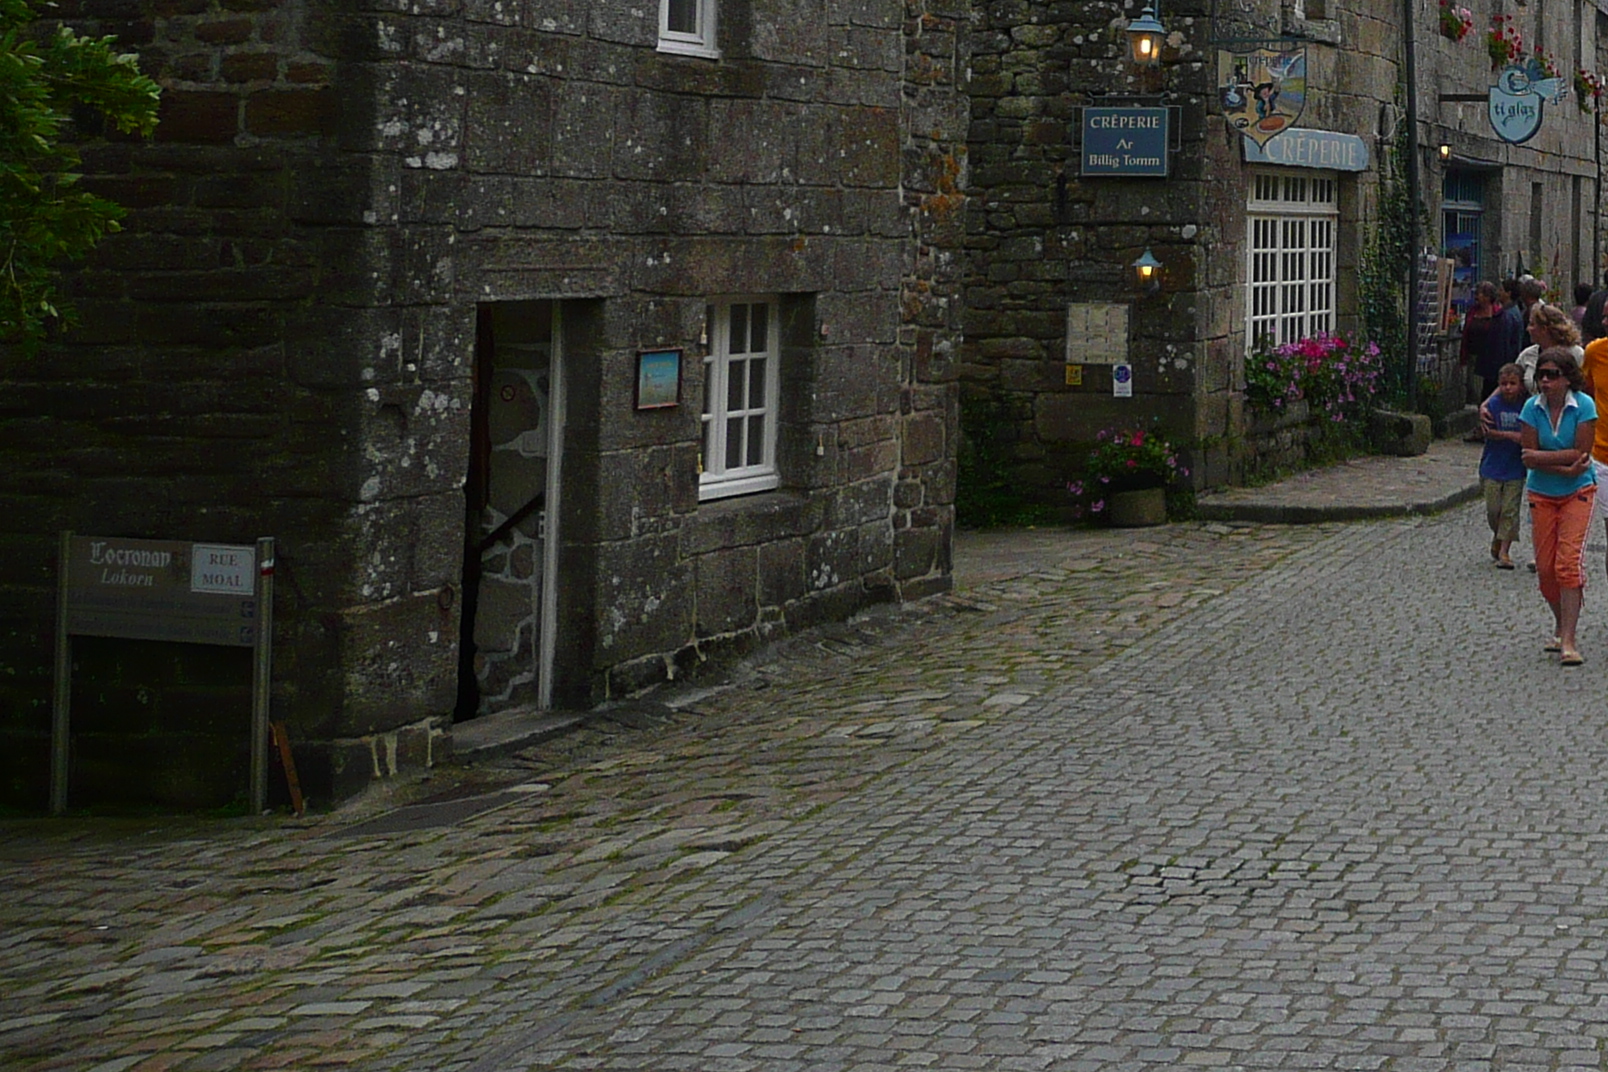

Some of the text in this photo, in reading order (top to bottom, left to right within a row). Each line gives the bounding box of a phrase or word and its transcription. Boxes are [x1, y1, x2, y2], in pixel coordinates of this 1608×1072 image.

[1090, 114, 1160, 129] CRÊPERIE
[1494, 100, 1535, 127] ti glaz
[1116, 138, 1134, 150] Ar
[1266, 131, 1357, 166] CRÊPERIE
[1089, 154, 1160, 168] Billig Tomm
[89, 541, 171, 568] Locronan
[209, 552, 239, 568] RUE
[101, 568, 153, 587] Lokorn
[202, 572, 244, 588] MOAL
